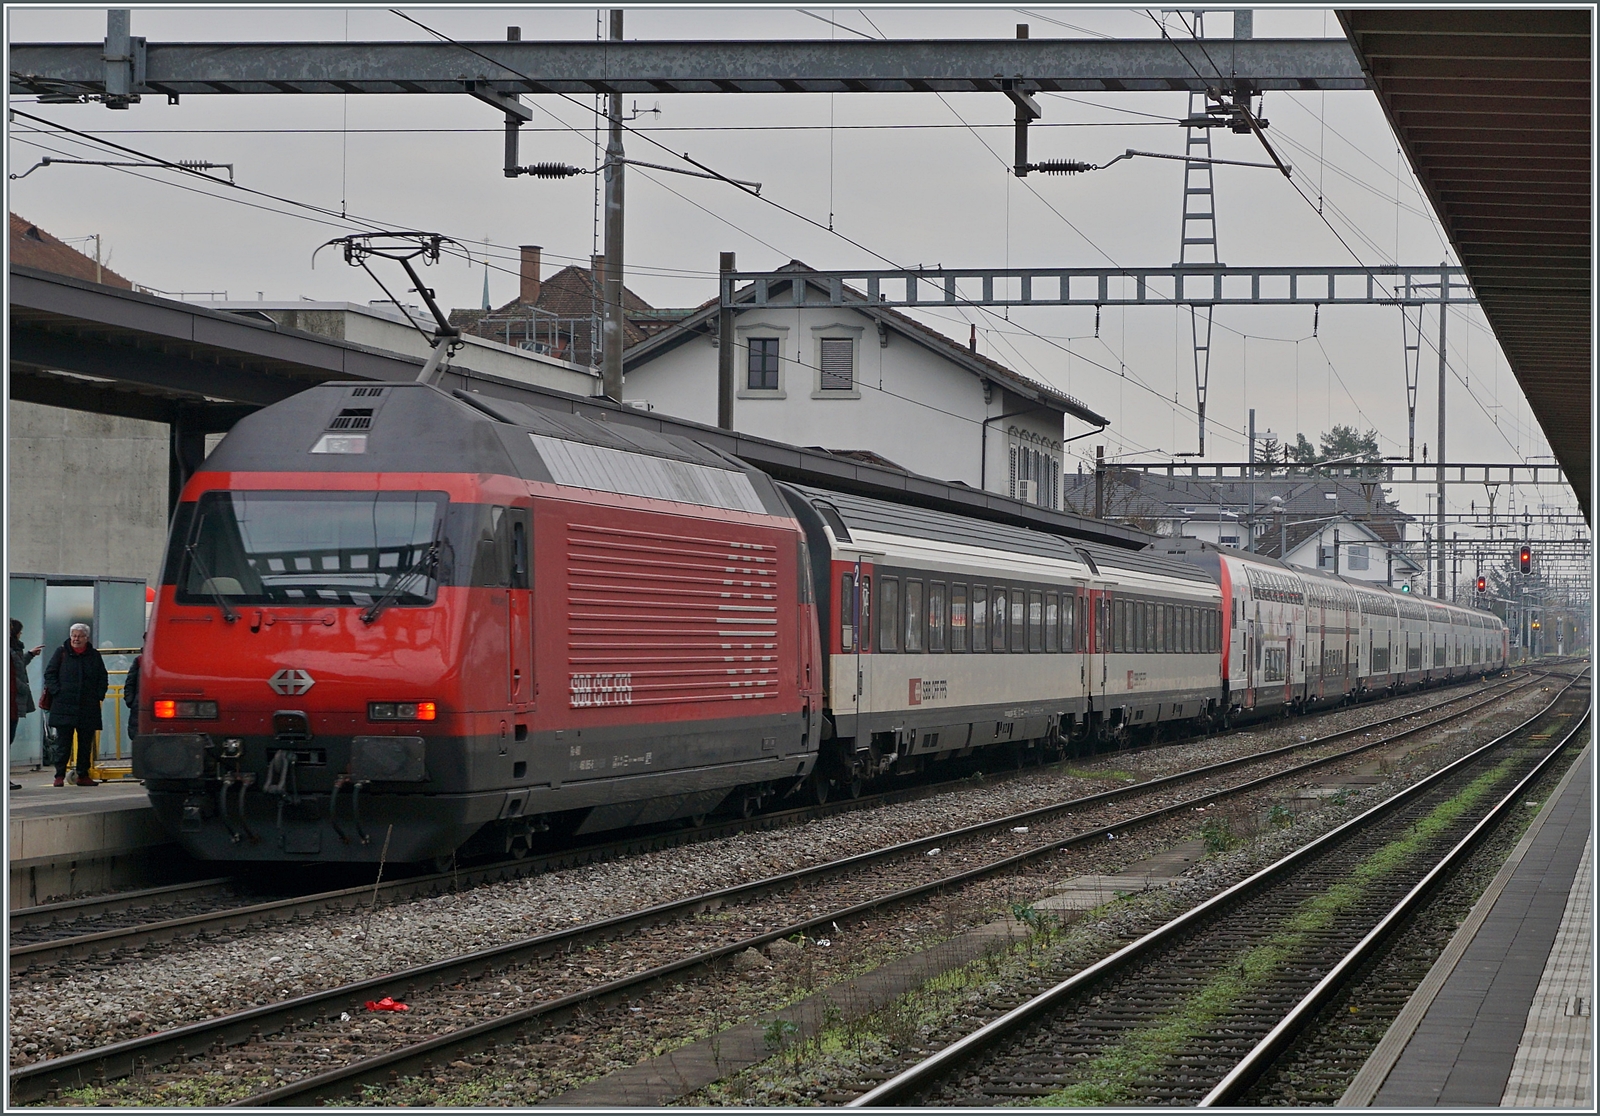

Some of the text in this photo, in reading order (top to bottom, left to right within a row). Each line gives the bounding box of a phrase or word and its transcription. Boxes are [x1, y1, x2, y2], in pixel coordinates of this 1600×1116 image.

[854, 565, 859, 587] 2
[570, 673, 632, 707] SBB CFF FFS
[922, 681, 931, 700] SBB
[940, 680, 948, 699] FFS
